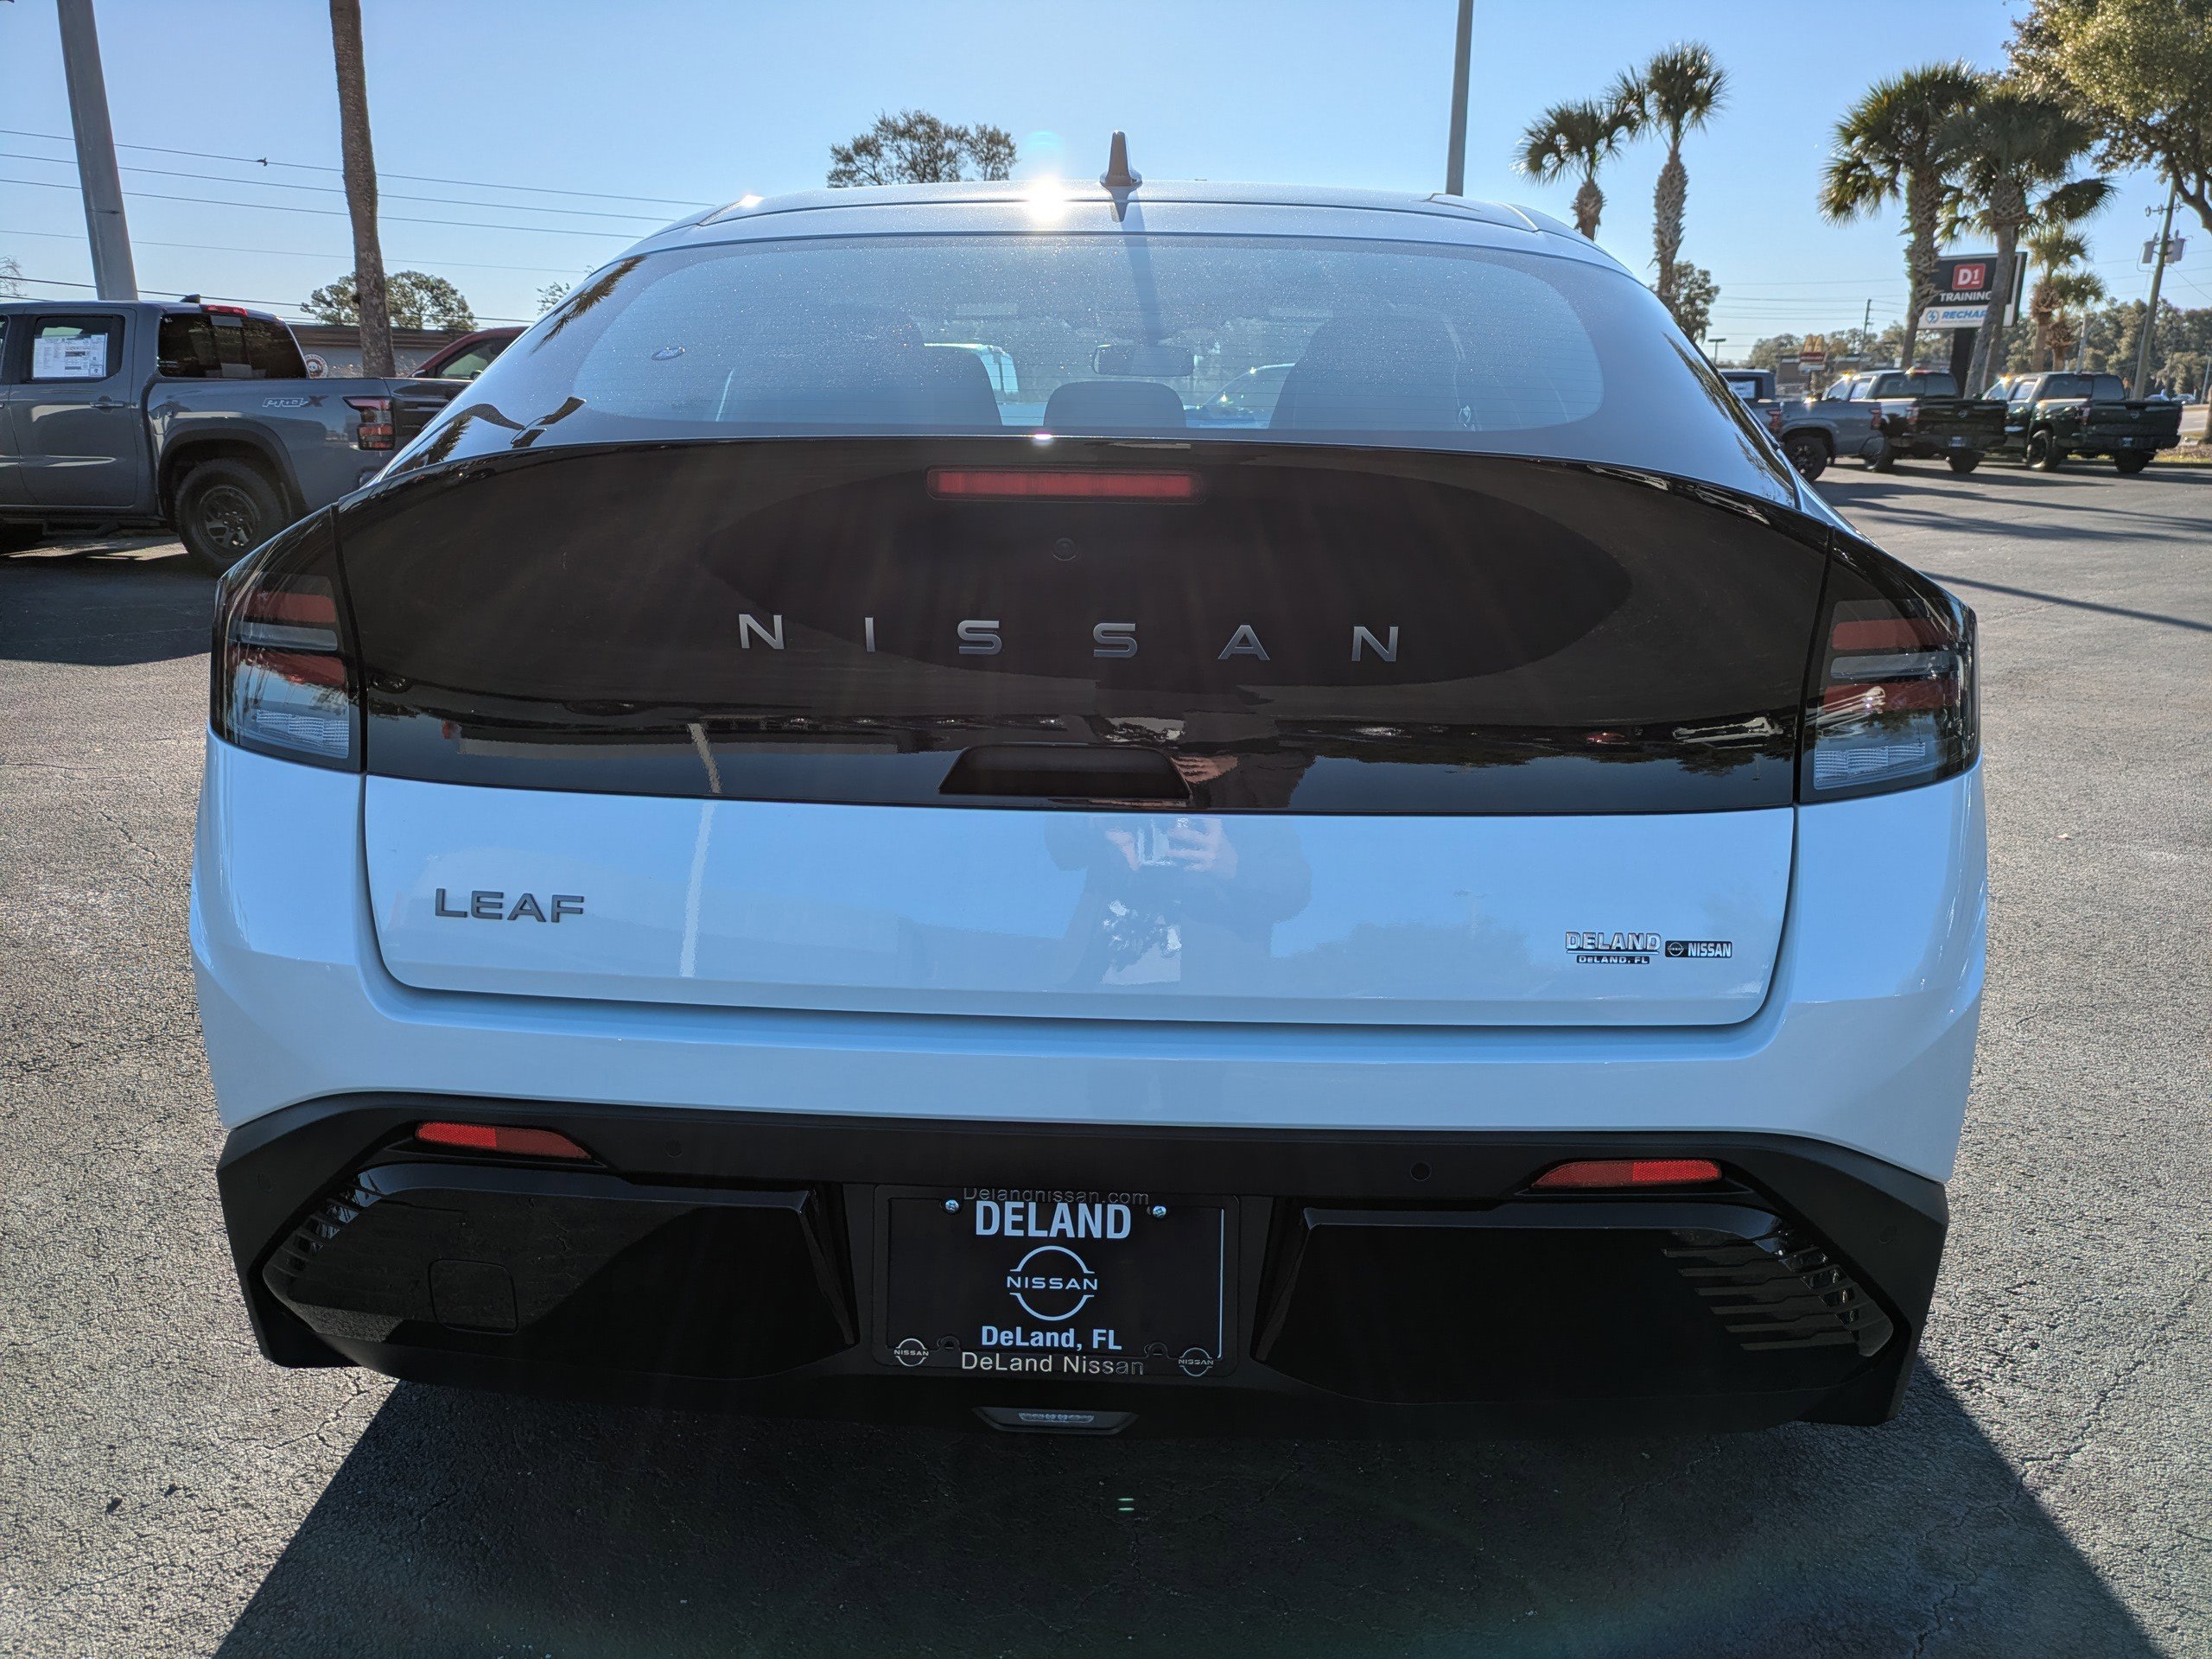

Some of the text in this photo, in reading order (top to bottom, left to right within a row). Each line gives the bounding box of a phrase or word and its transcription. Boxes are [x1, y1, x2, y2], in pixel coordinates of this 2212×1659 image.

[1957, 268, 1980, 285] D1
[738, 613, 1399, 662] NISSAN
[435, 887, 585, 923] LEAF
[1566, 931, 1732, 957] DELAND NISSAN
[976, 1200, 1131, 1239] DELAND
[1007, 1276, 1097, 1290] NISSAN
[982, 1325, 1122, 1351] DeLand, FL
[962, 1351, 1143, 1376] DeLand Nissan
